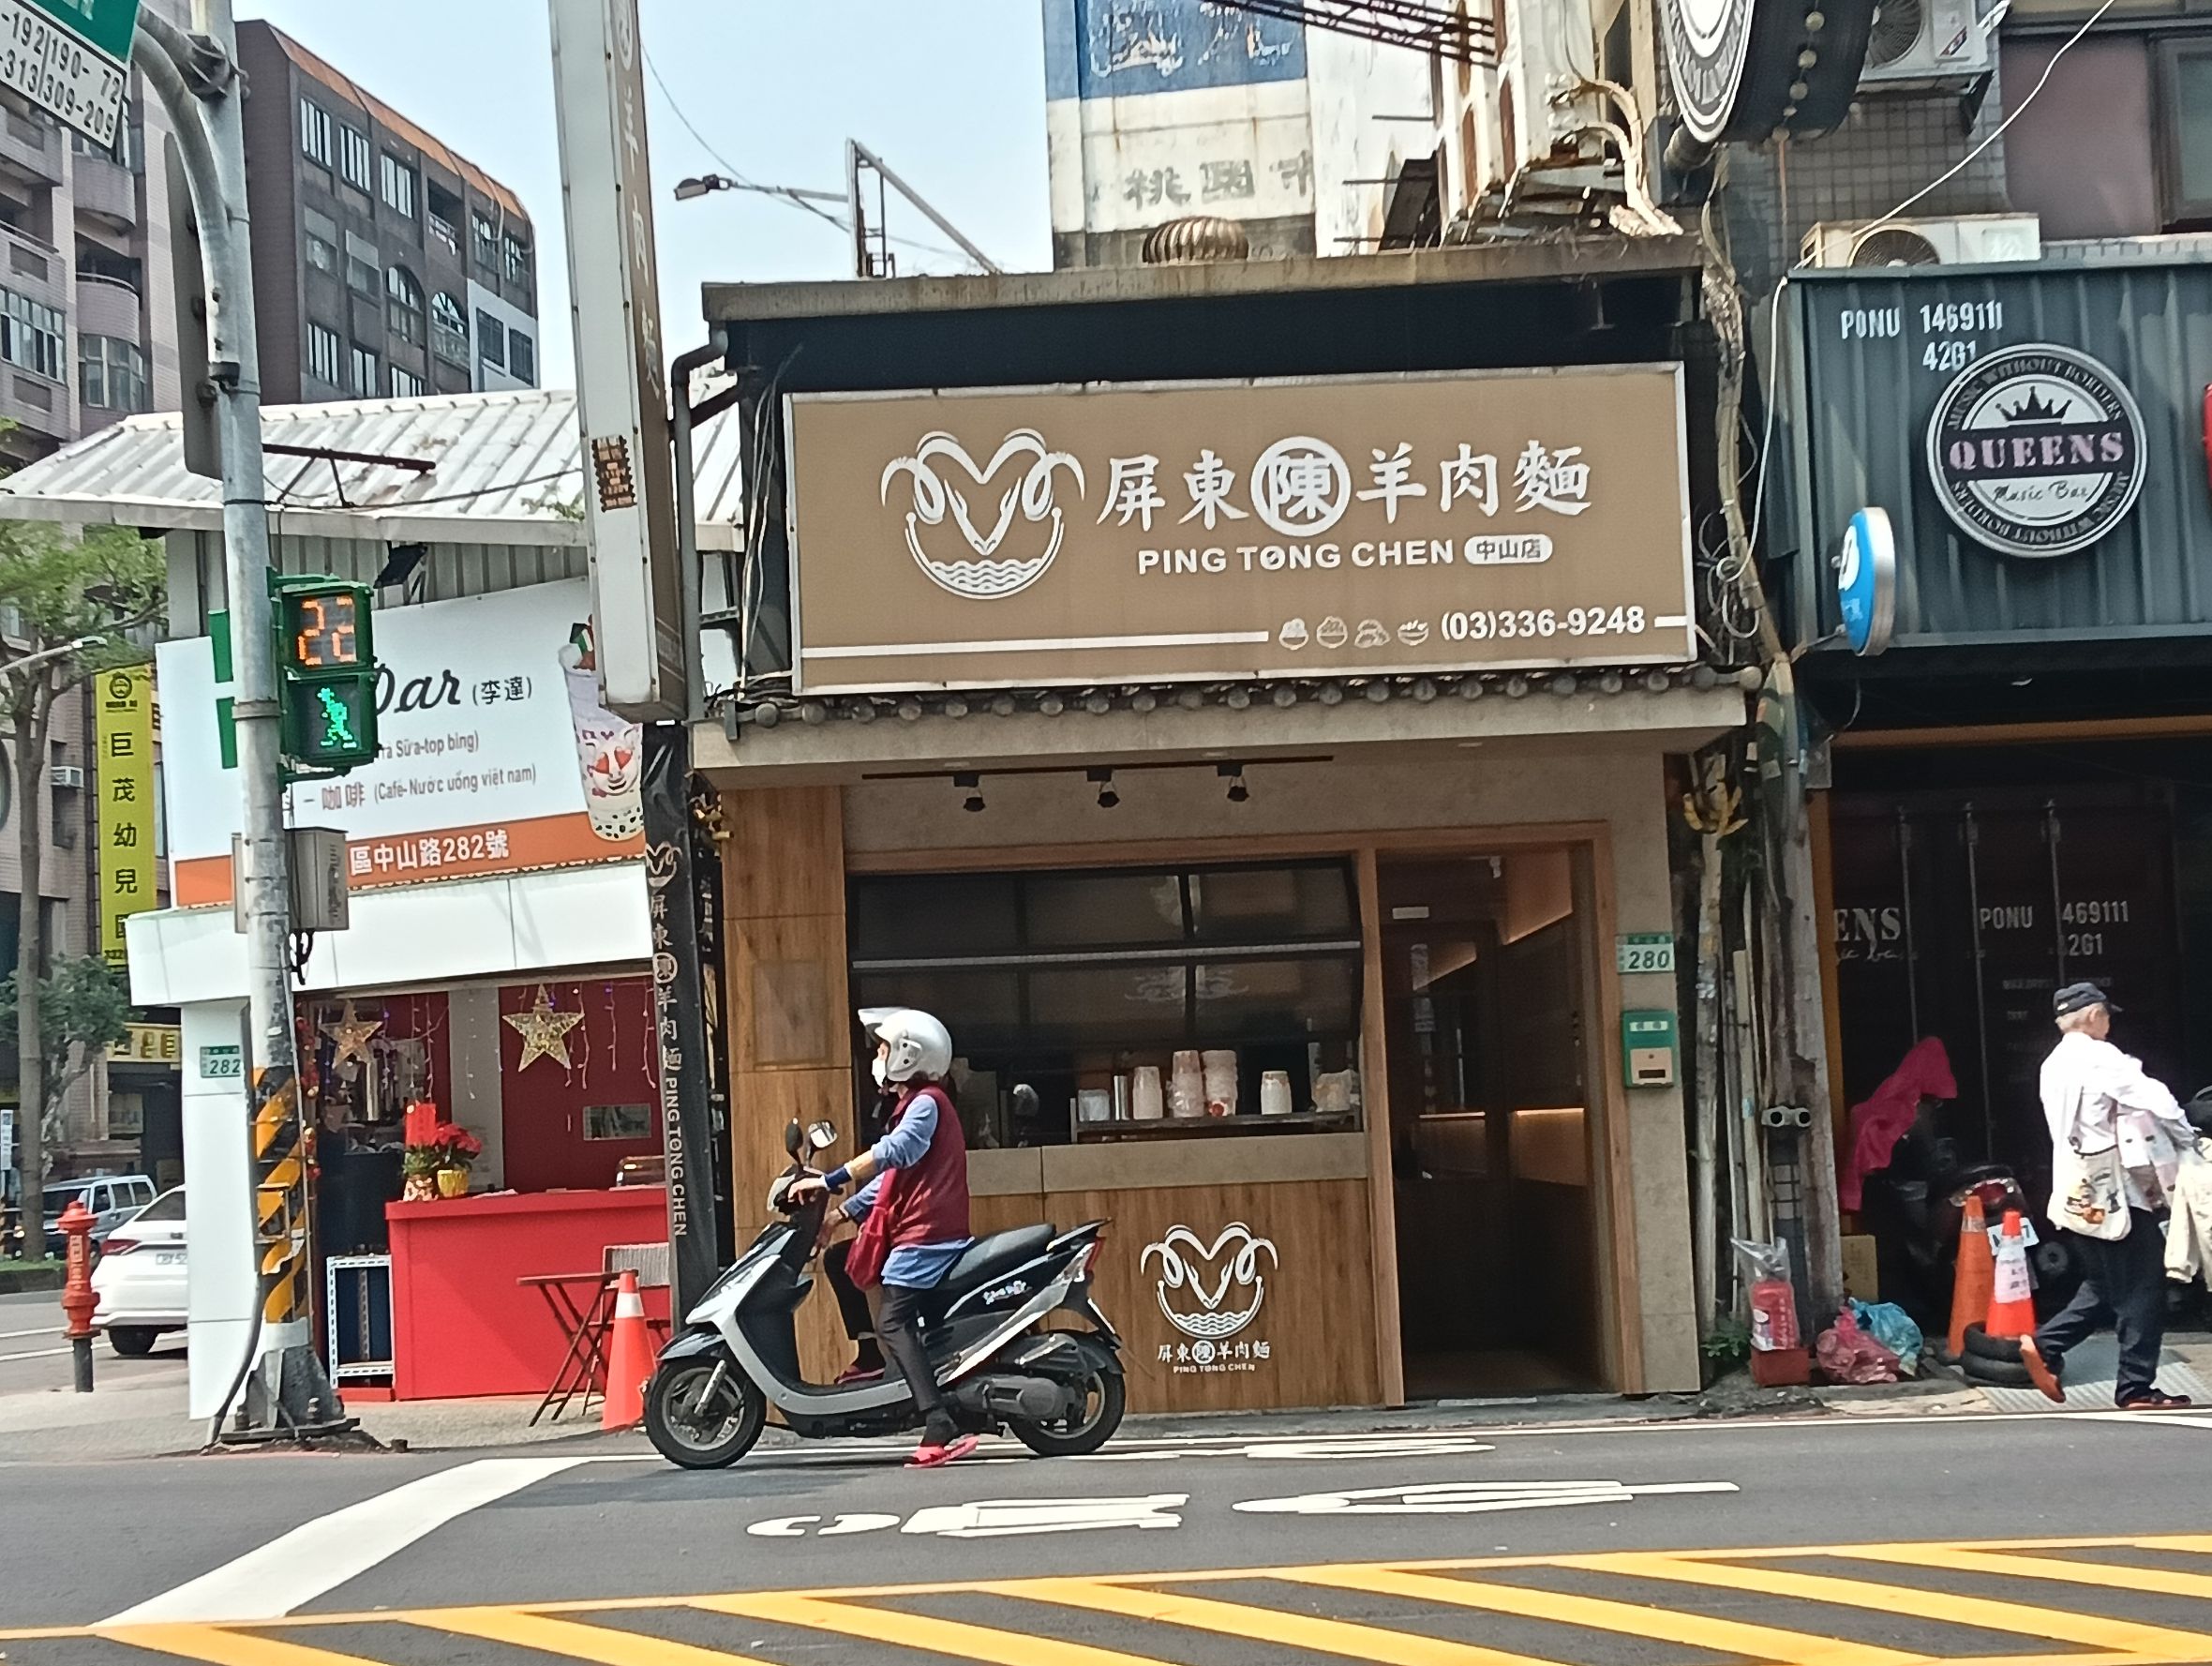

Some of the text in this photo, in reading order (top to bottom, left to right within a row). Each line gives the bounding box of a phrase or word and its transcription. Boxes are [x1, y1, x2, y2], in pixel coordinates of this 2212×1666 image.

[43, 73, 113, 141] 309-209
[1840, 308, 1901, 339] PONU
[1922, 340, 1977, 372] 42G1
[1949, 432, 2125, 470] QUEENS
[1097, 436, 1592, 536] 屏東陳羊肉麵
[1138, 548, 1227, 575] PING
[1352, 540, 1454, 567] CHEN
[1475, 537, 1542, 561] 中山店
[1441, 606, 1646, 641] (03)336-9248
[471, 675, 532, 706] (李達)
[1979, 905, 2033, 930] PONU
[1628, 950, 1670, 969] 280
[209, 1058, 241, 1074] 282
[665, 1076, 680, 1123] PING
[671, 1183, 688, 1237] CHEN
[1173, 1364, 1197, 1374] PING
[1228, 1362, 1256, 1373] CHEN
